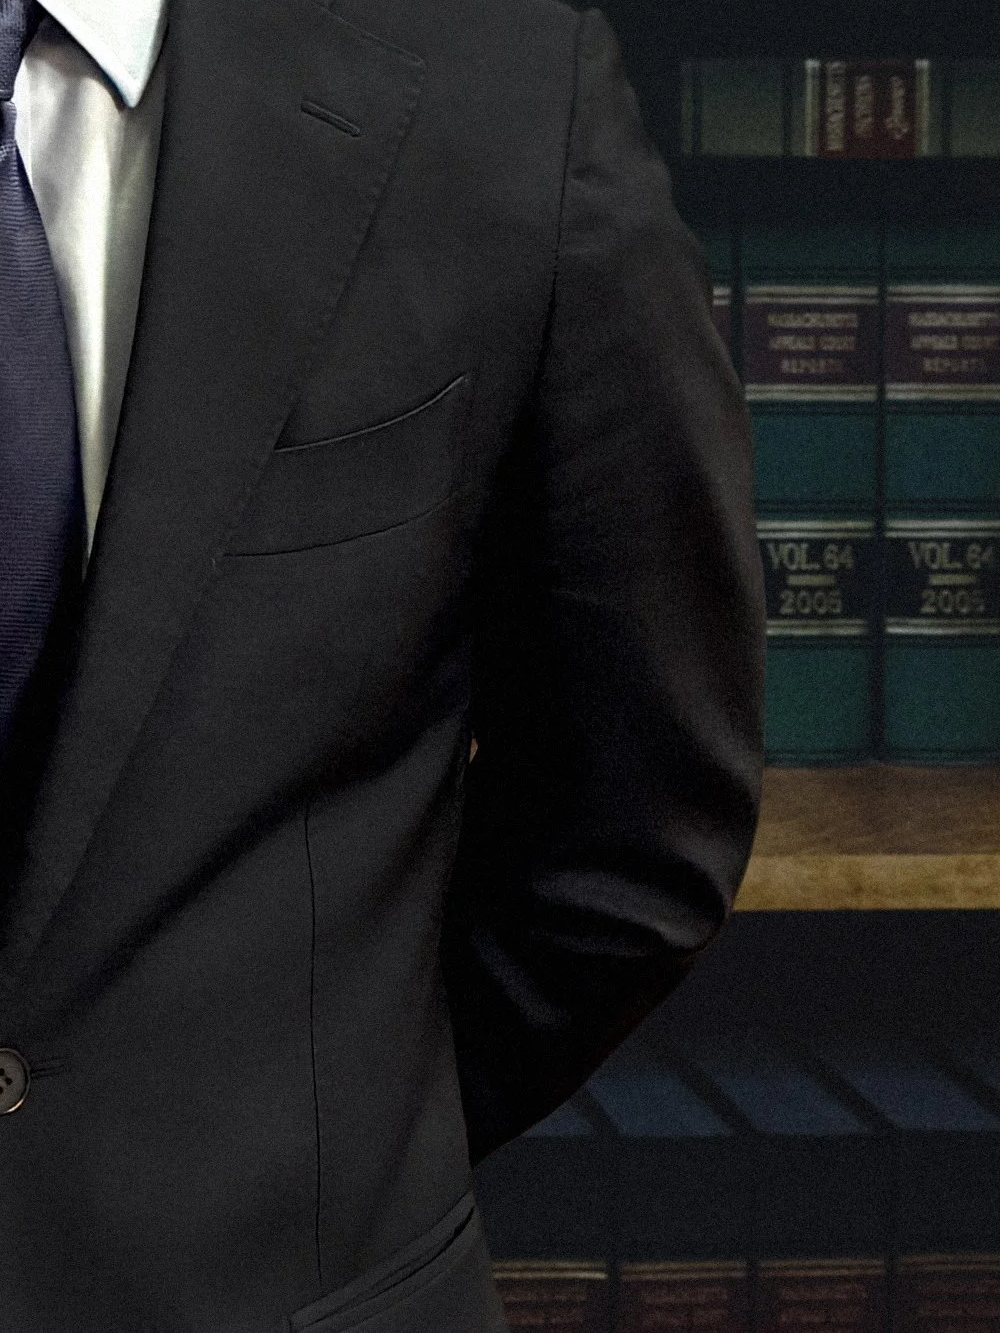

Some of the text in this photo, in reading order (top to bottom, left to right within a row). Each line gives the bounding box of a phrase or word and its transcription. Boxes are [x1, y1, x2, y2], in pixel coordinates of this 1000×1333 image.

[767, 542, 855, 571] VOL. 64
[907, 541, 963, 570] VOL.
